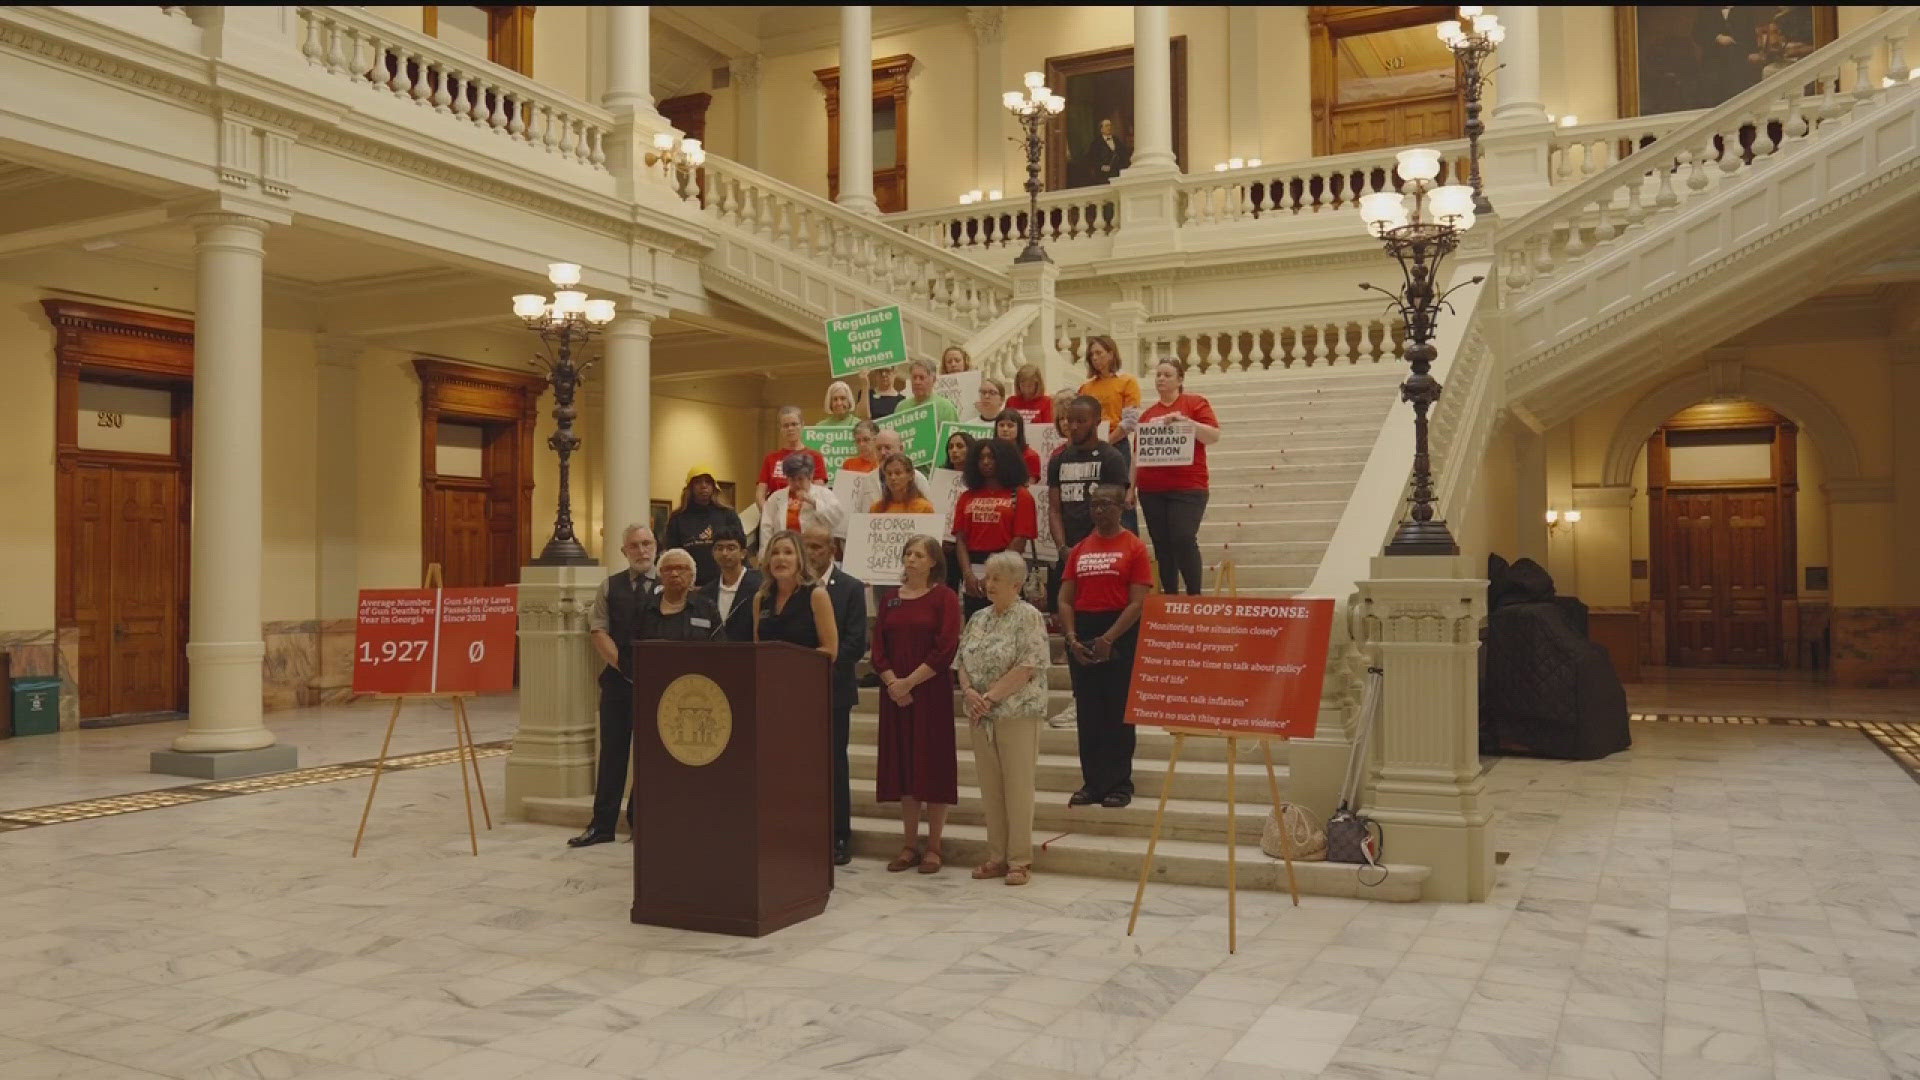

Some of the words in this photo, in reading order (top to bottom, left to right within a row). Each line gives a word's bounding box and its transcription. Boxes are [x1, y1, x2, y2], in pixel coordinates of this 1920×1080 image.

[833, 310, 893, 333] Regulate
[848, 328, 882, 343] Guns
[851, 338, 881, 355] NOT
[843, 350, 894, 368] Women
[879, 410, 928, 431] egulate
[1139, 426, 1175, 436] MOMS
[1139, 436, 1187, 446] DEMAND
[821, 444, 857, 454] Guns
[1139, 447, 1180, 456] ACTION
[870, 518, 915, 530] GEORGIA
[361, 600, 396, 608] Average
[397, 599, 431, 607] Number
[463, 597, 489, 605] Safety
[391, 607, 420, 615] Deaths
[421, 607, 435, 615] Per
[444, 606, 471, 614] Passed
[483, 606, 514, 614] Georgia
[1164, 602, 1191, 614] THE
[1193, 604, 1233, 616] GOP'S
[1235, 605, 1309, 619] RESPONSE:
[381, 616, 390, 624] in
[391, 616, 424, 625] Georgia
[1196, 624, 1209, 633] the
[1211, 626, 1248, 634] situation
[1185, 642, 1201, 650] and
[359, 640, 429, 666] 1,927
[1164, 657, 1171, 666] is
[1172, 659, 1186, 667] not
[1187, 659, 1201, 668] the
[1202, 660, 1222, 669] time
[1223, 662, 1232, 670] to
[1233, 662, 1249, 670] talk
[1250, 663, 1275, 672] about
[1160, 675, 1170, 683] of
[1166, 695, 1189, 704] guns,
[1190, 695, 1206, 704] talk
[1177, 713, 1197, 721] such
[1198, 715, 1220, 726] thing
[1232, 718, 1249, 727] gun
